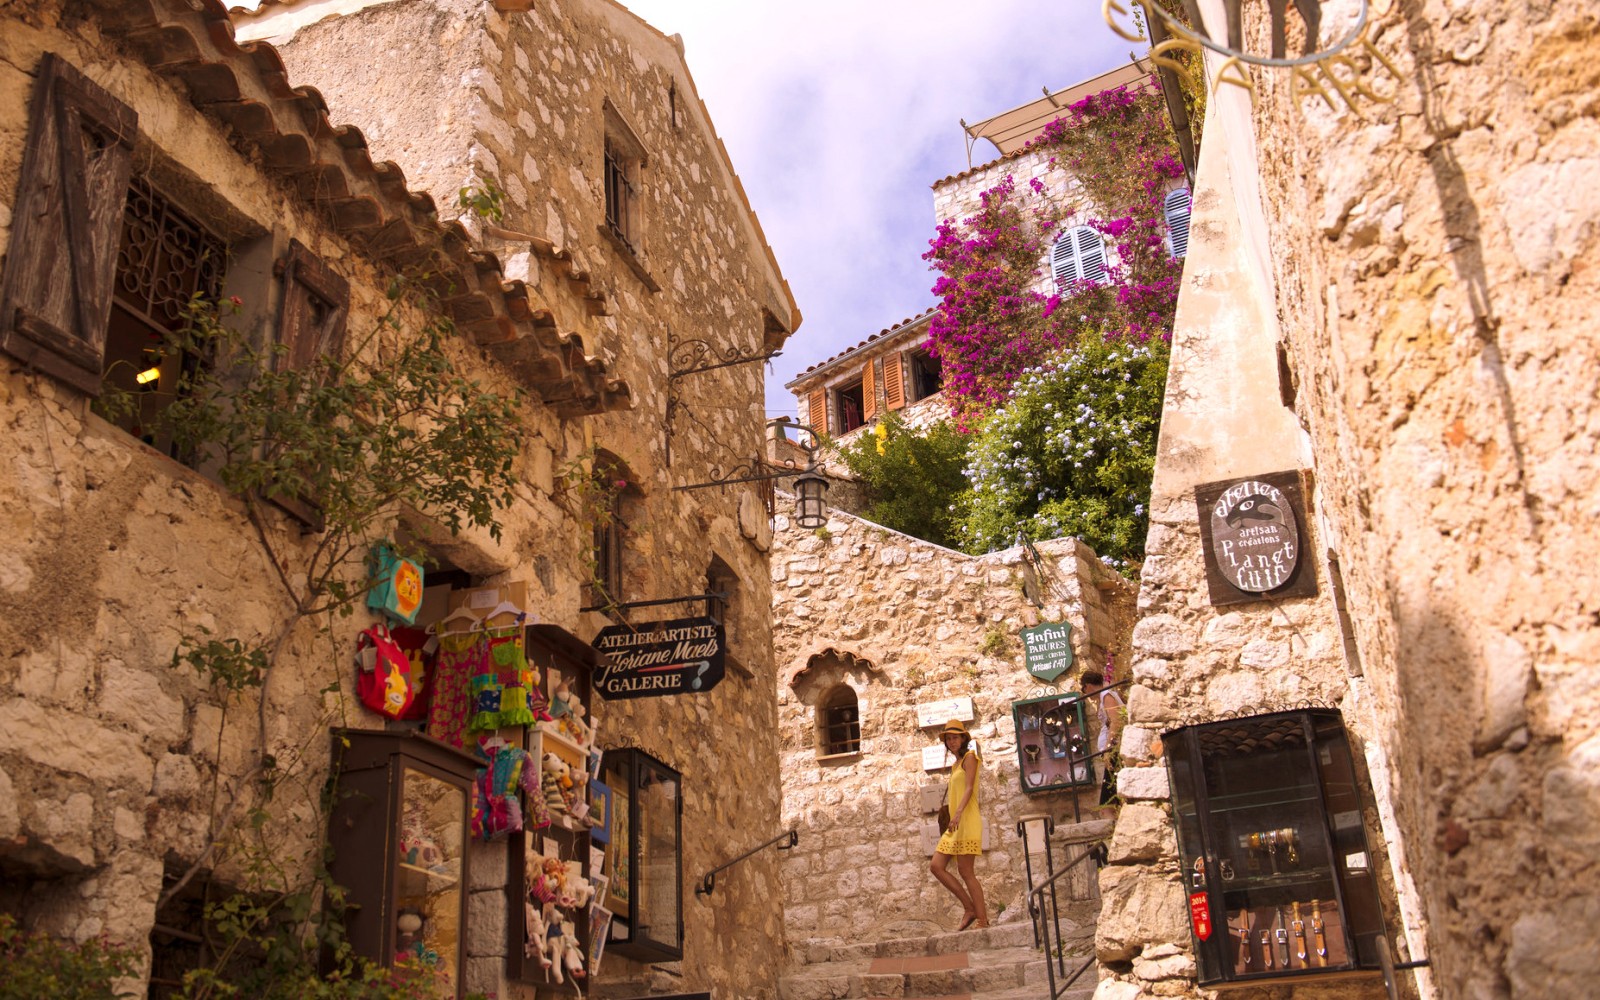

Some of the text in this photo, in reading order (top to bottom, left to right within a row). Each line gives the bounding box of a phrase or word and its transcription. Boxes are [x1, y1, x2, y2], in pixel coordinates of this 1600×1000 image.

[1215, 481, 1280, 518] atelier
[1240, 525, 1278, 538] artisan
[1238, 535, 1280, 547] créations
[599, 632, 657, 648] ATELIER
[1026, 626, 1066, 645] Infini
[1029, 641, 1066, 654] PARURES
[607, 674, 681, 692] GALERIE
[1192, 896, 1206, 905] 2014
